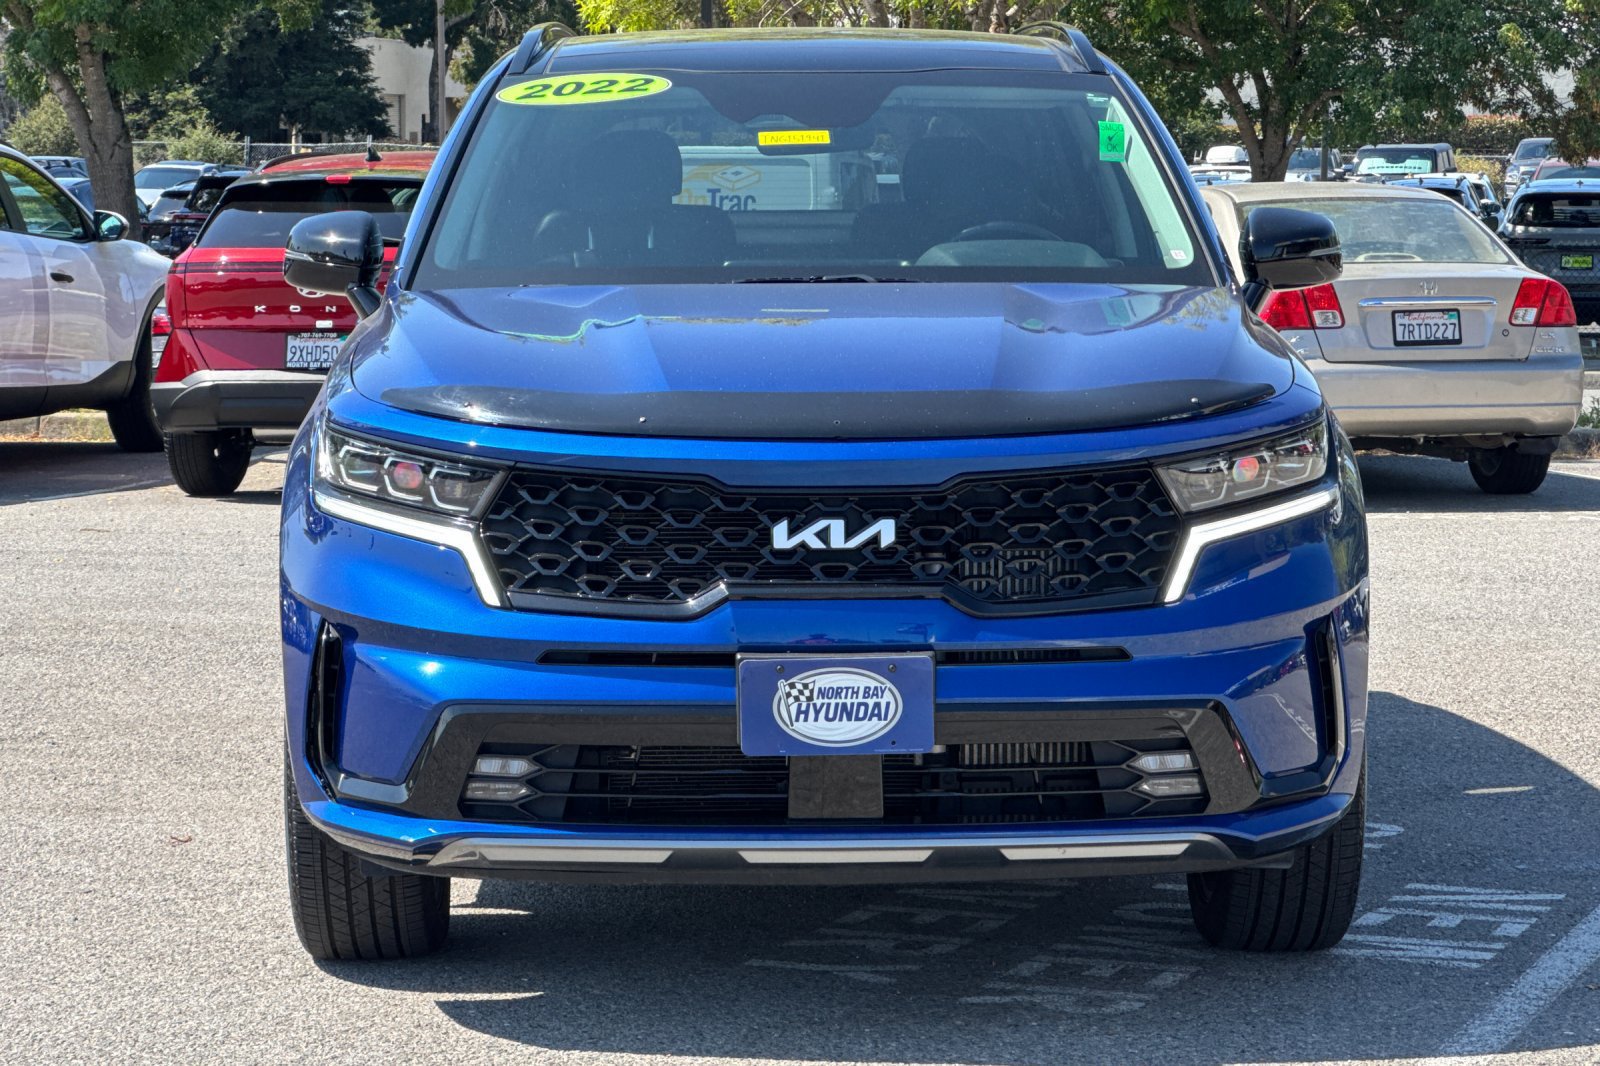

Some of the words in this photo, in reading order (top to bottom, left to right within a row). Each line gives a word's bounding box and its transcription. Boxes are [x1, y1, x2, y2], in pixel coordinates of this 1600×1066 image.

[515, 77, 657, 100] 2022
[1100, 123, 1124, 132] SMOG
[1106, 143, 1118, 152] OK
[254, 305, 337, 313] KON
[1398, 323, 1457, 340] 7RTD227
[289, 345, 340, 362] 9XHD50
[772, 518, 896, 549] KIA
[816, 686, 862, 700] NORTH
[862, 685, 889, 699] BAY
[794, 701, 891, 723] HYUNDAI
